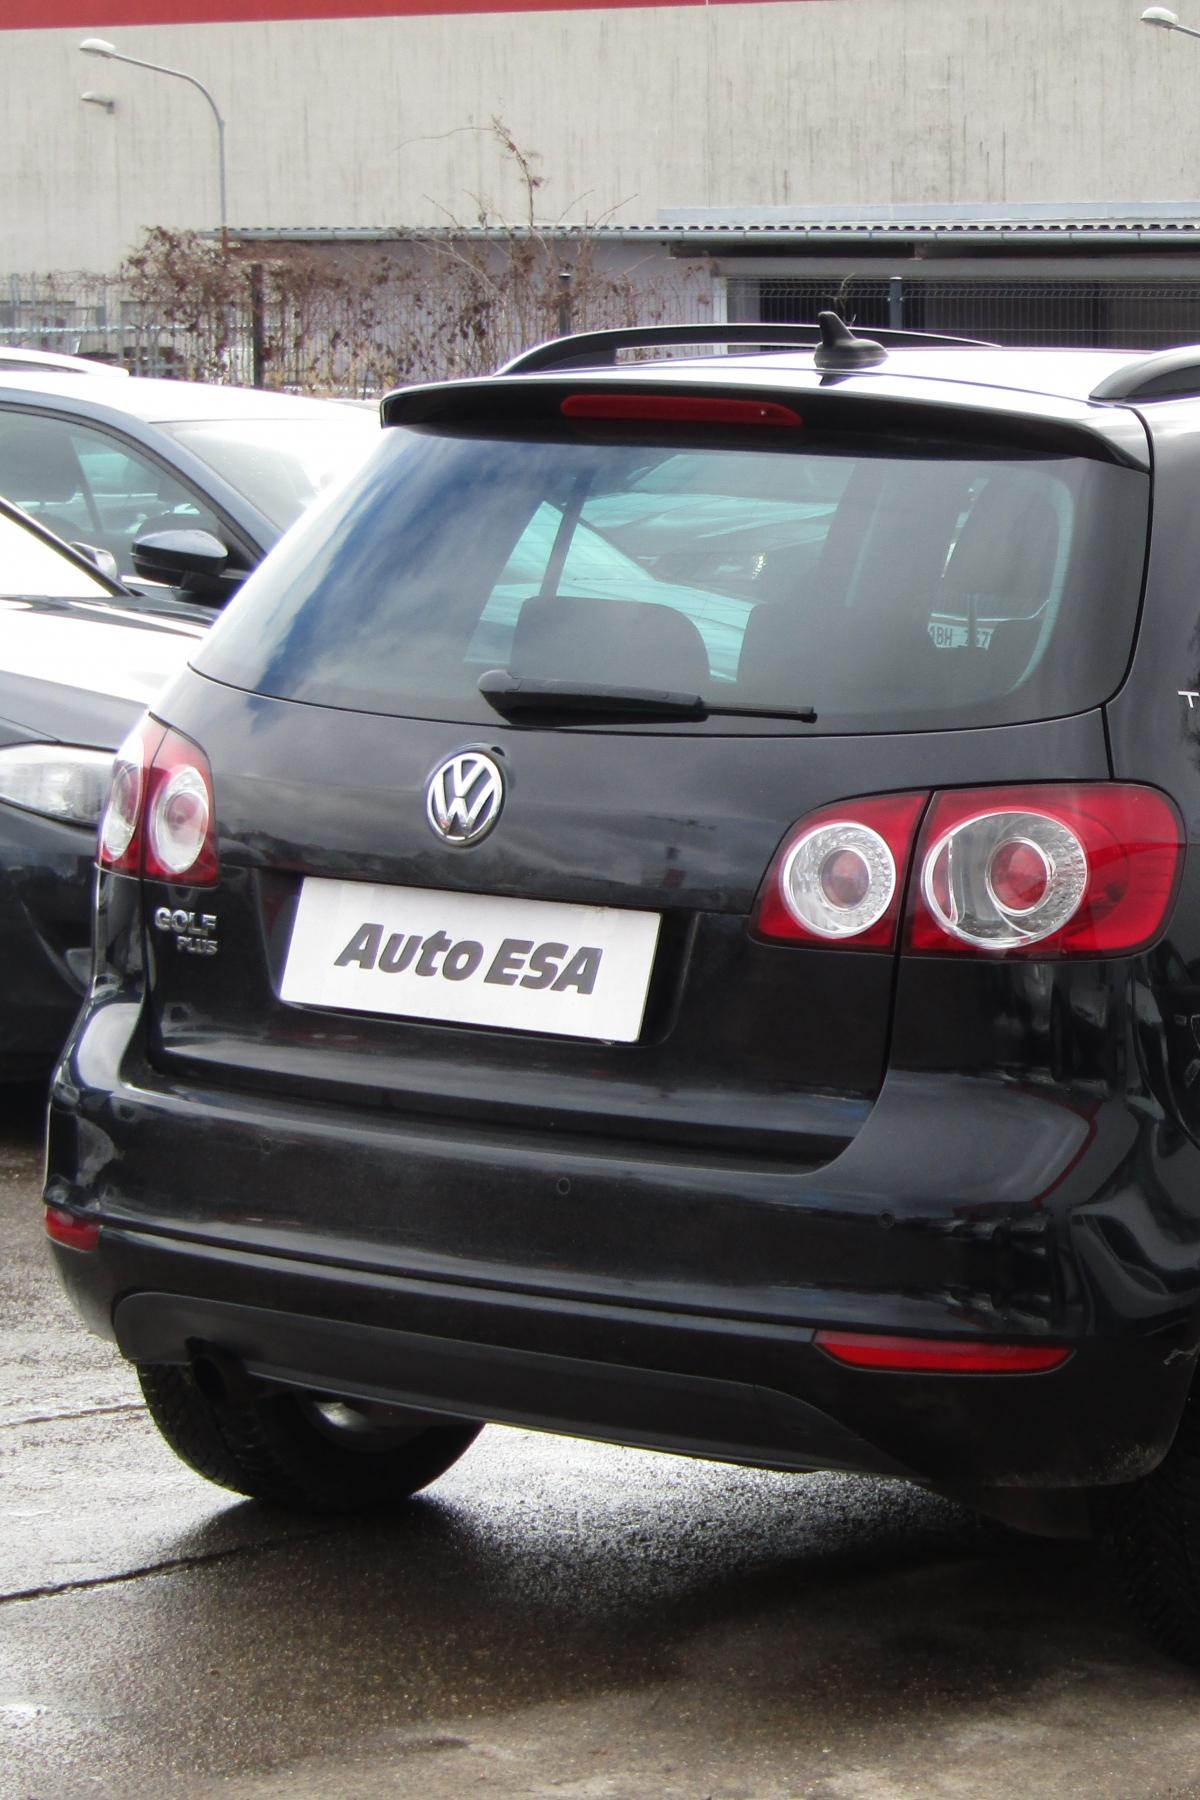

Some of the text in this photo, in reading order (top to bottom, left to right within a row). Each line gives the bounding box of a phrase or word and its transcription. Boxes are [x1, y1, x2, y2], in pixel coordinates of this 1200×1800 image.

[154, 906, 218, 936] GOLF
[176, 935, 219, 956] PLUS
[333, 922, 604, 995] Auto ESA
